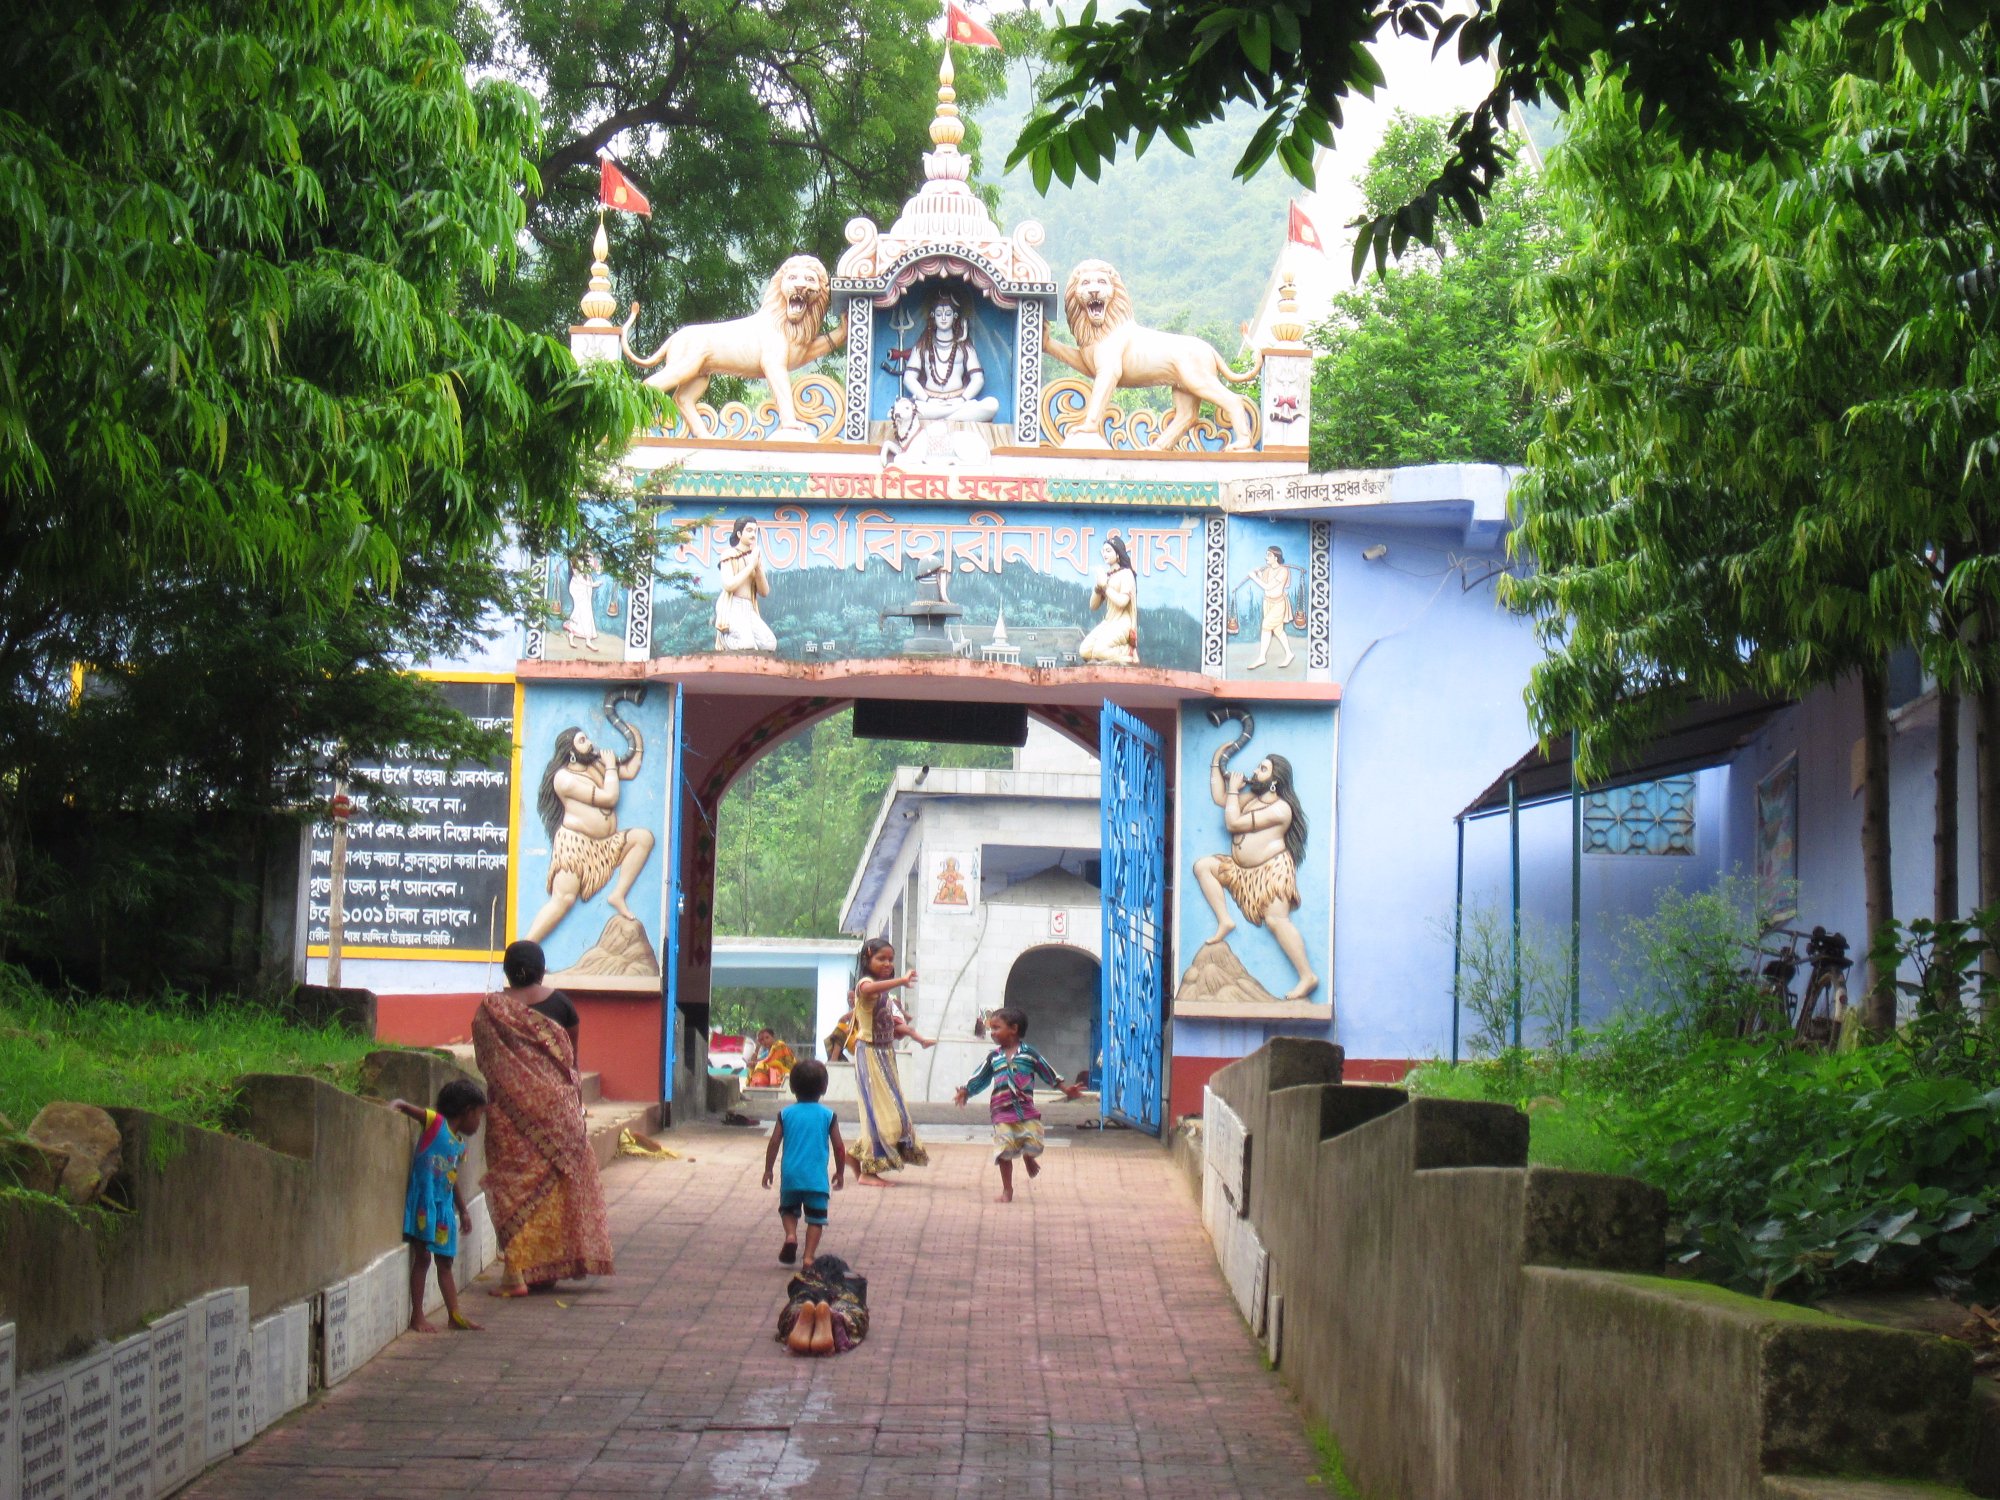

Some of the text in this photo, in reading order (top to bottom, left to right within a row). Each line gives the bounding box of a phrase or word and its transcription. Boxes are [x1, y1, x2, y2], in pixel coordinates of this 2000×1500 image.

[856, 508, 1095, 576] বিহারীনাথ
[413, 768, 446, 787] হওয়া
[412, 797, 440, 814] হবে
[375, 822, 405, 840] এবং
[407, 822, 441, 842] প্রসাদ
[443, 821, 471, 841] নিয়ে
[473, 821, 509, 845] মন্দির
[454, 854, 477, 872] করা
[349, 879, 377, 896] জন্য
[379, 878, 401, 901] দুধ
[385, 902, 420, 925] টাকা
[362, 928, 389, 944] মন্দির
